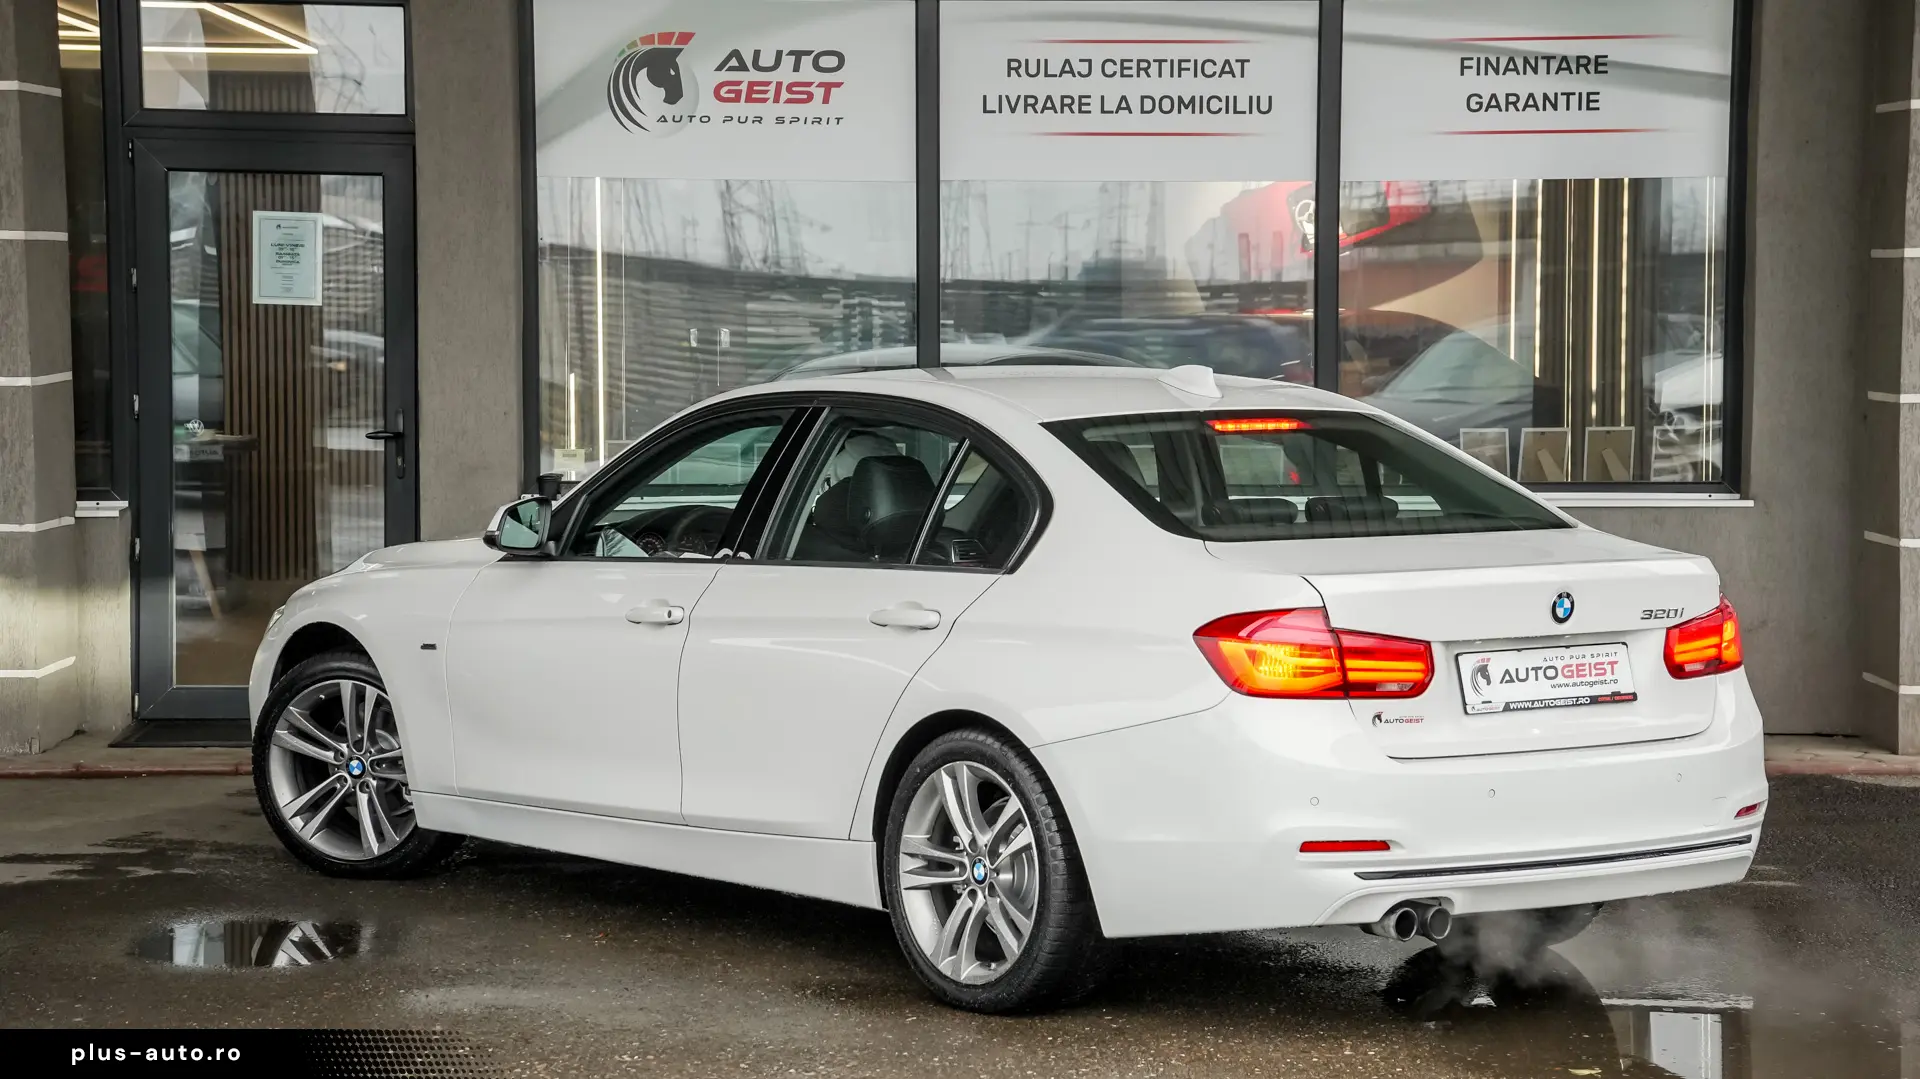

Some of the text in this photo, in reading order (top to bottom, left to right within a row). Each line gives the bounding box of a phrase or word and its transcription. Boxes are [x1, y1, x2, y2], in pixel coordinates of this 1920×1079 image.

[713, 48, 846, 74] AUTO
[1006, 58, 1251, 79] RULAJ CERTIFICAT
[1460, 54, 1609, 77] FINANTARE
[713, 80, 845, 105] GEIST
[1466, 91, 1601, 113] GARANTIE
[982, 94, 1273, 115] LIVRARE LA DOMICILIU
[656, 114, 844, 126] AUTO PUR SPIRIT
[1640, 607, 1685, 621] 320i
[1542, 651, 1619, 663] AUTO PUR SPIRIT
[1550, 678, 1619, 689] www.autogeist.ro
[1509, 696, 1591, 709] WWW.AUTOGEIST.RO
